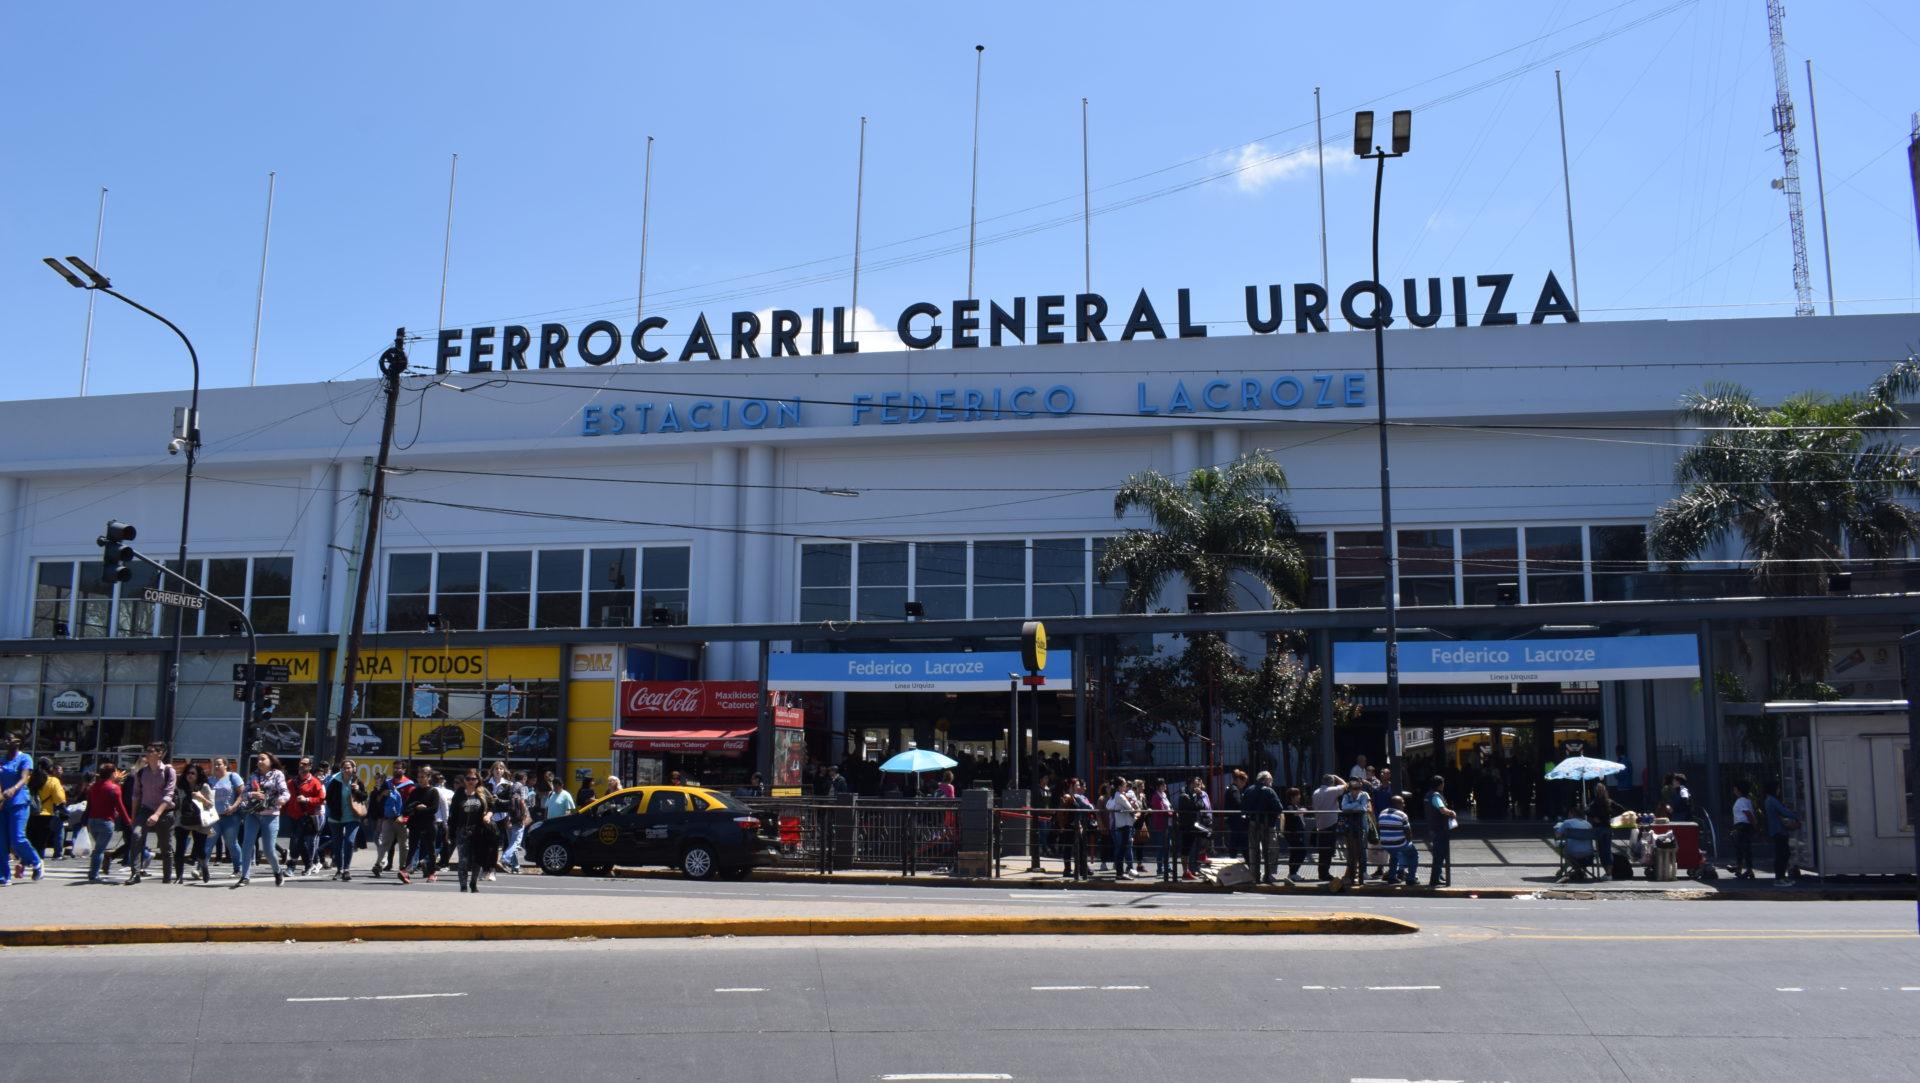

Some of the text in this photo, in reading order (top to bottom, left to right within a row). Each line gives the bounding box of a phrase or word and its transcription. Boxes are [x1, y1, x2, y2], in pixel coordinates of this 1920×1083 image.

[436, 269, 1580, 374] FERROCARRIL GENERAL URQUIZA
[581, 373, 1366, 436] ESTACION FEDERICO LACROZE
[144, 589, 203, 608] CORRIENTES
[344, 655, 393, 675] ARA
[410, 655, 483, 674] TODOS
[1431, 647, 1596, 663] Federico Lacroze
[848, 660, 984, 675] Federico Lacroze
[630, 687, 702, 712] Coca-Cola
